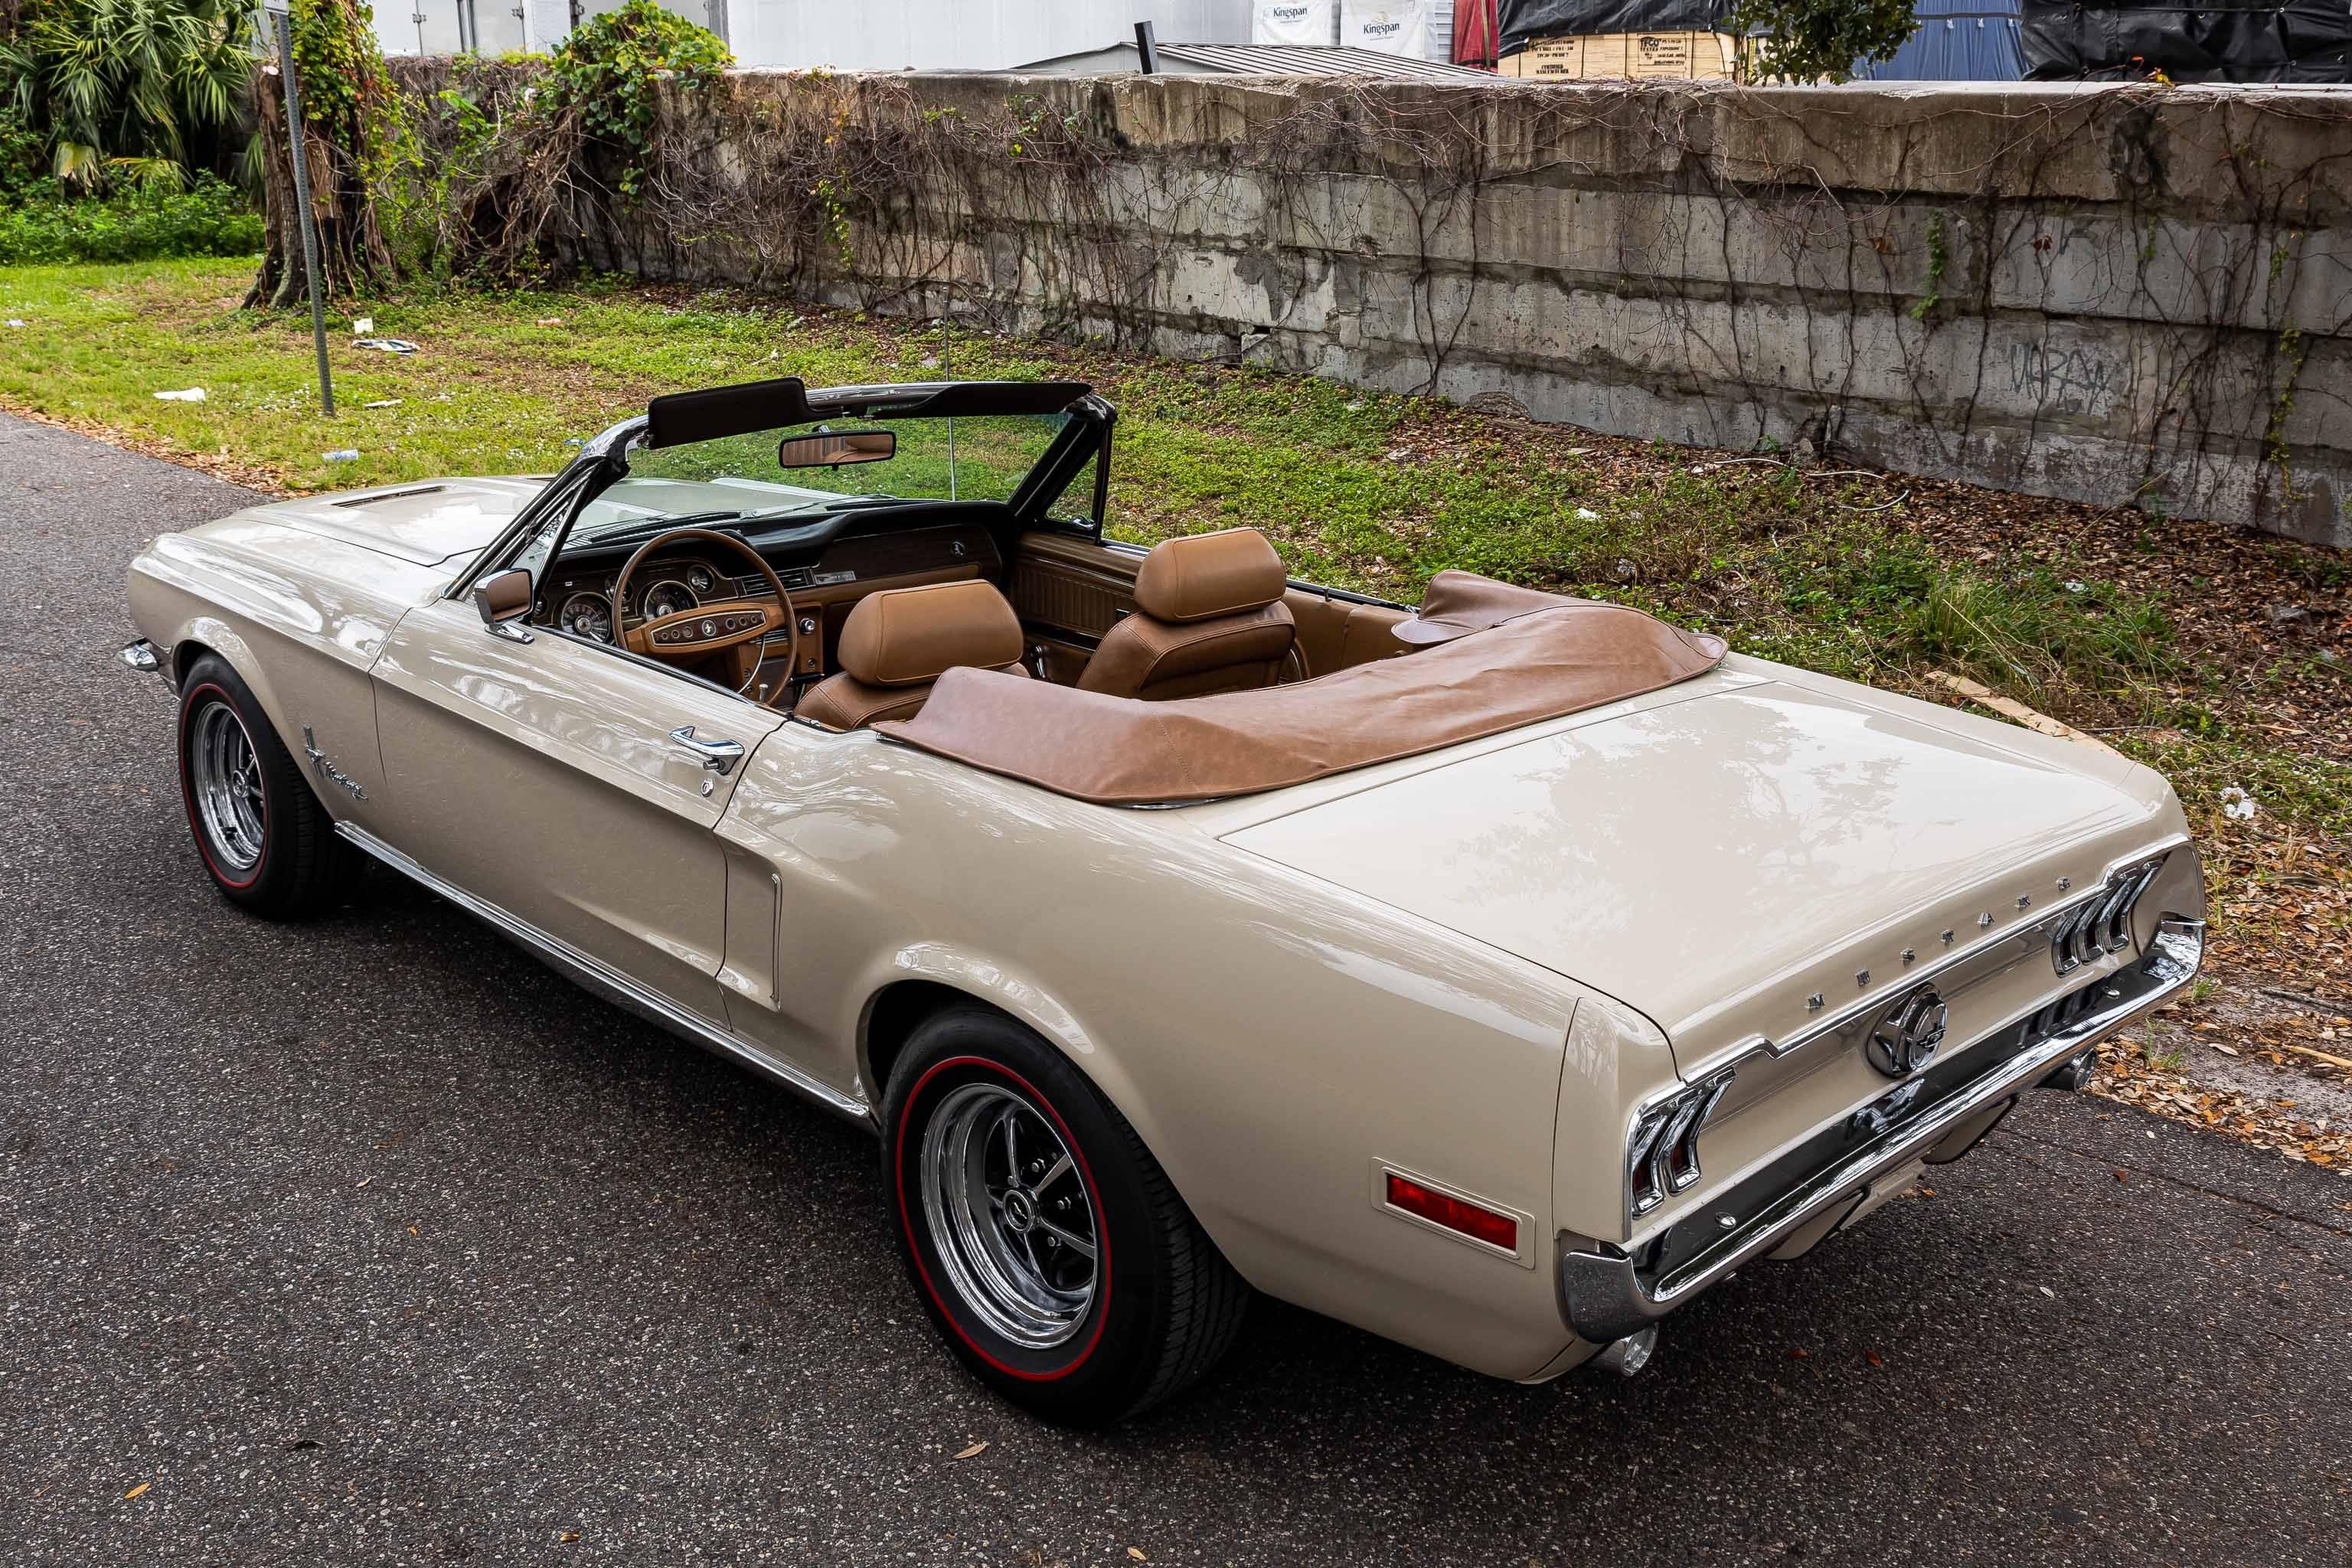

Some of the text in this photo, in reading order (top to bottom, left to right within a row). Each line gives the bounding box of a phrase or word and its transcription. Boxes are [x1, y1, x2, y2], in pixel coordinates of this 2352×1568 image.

[1273, 7, 1308, 18] Kingspan
[1364, 23, 1400, 35] Kingspan
[1805, 875, 2071, 1011] MUSTANG
